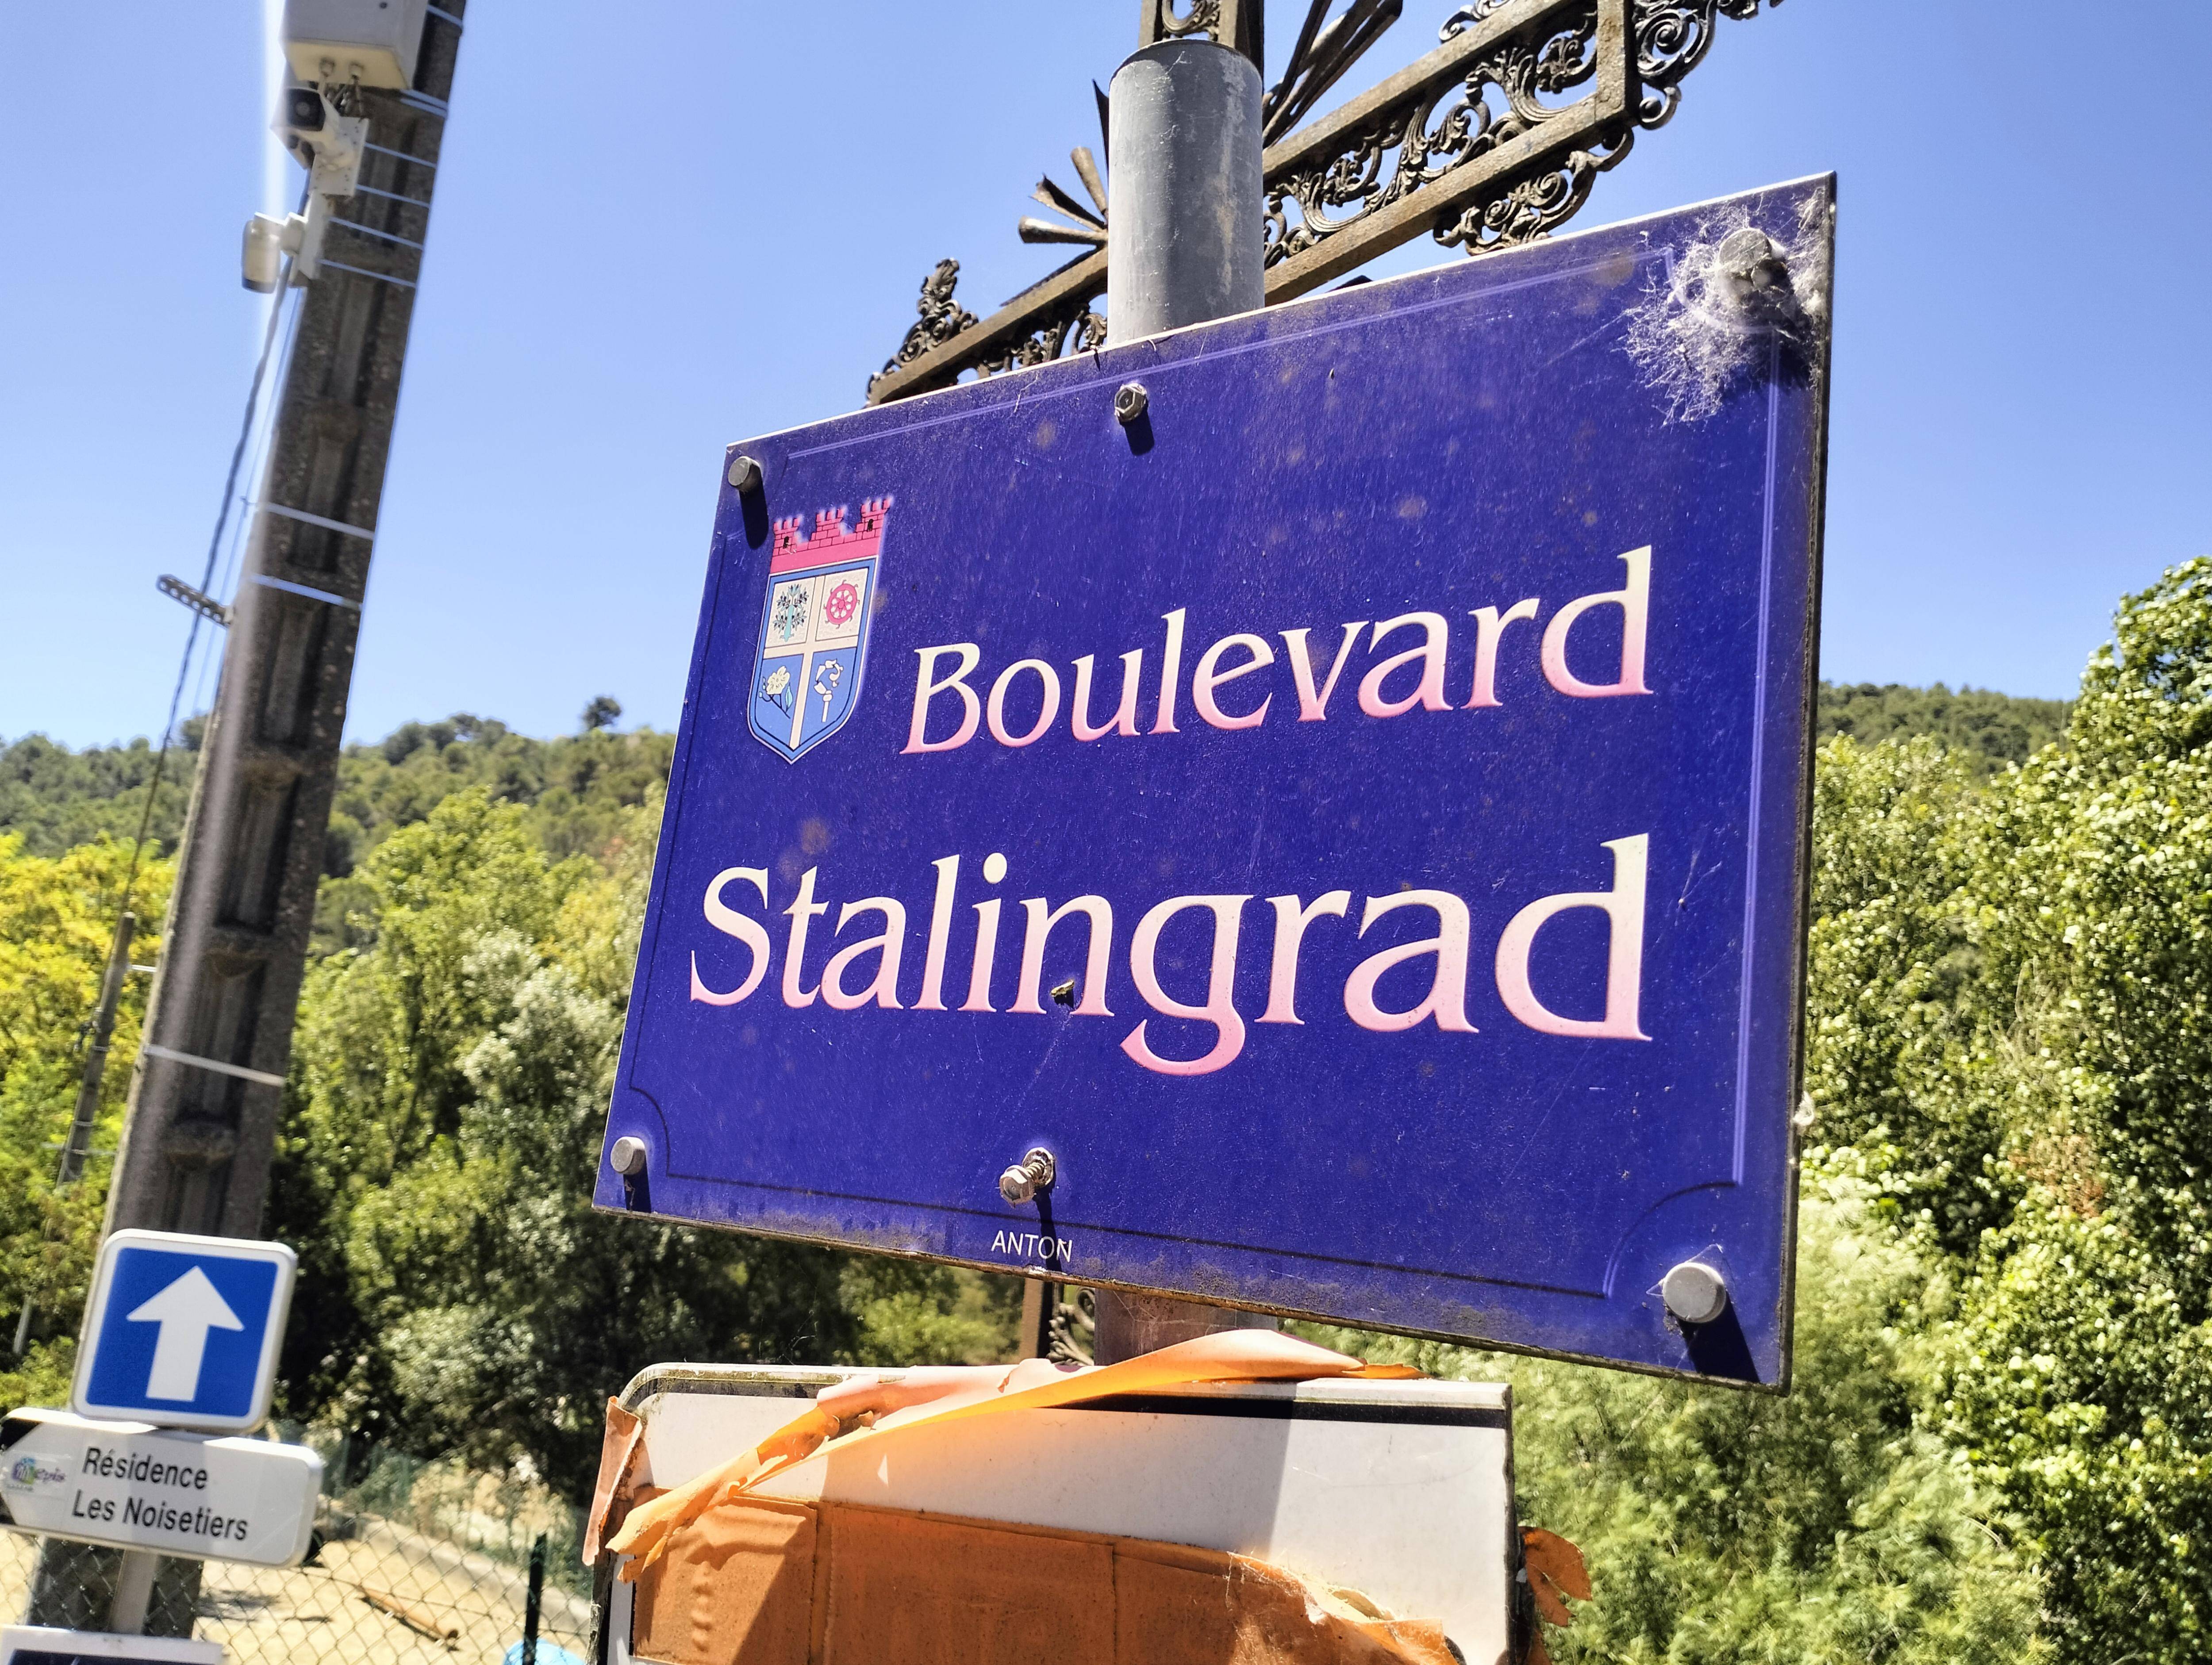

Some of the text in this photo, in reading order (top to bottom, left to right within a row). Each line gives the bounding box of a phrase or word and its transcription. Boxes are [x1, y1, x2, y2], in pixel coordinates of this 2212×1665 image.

[899, 545, 1654, 754] Boulevard
[691, 832, 1652, 1076] Stalingrad
[991, 1230, 1072, 1262] ANTON
[83, 1446, 208, 1490] Résidence
[72, 1489, 248, 1541] Les Noisetiers
